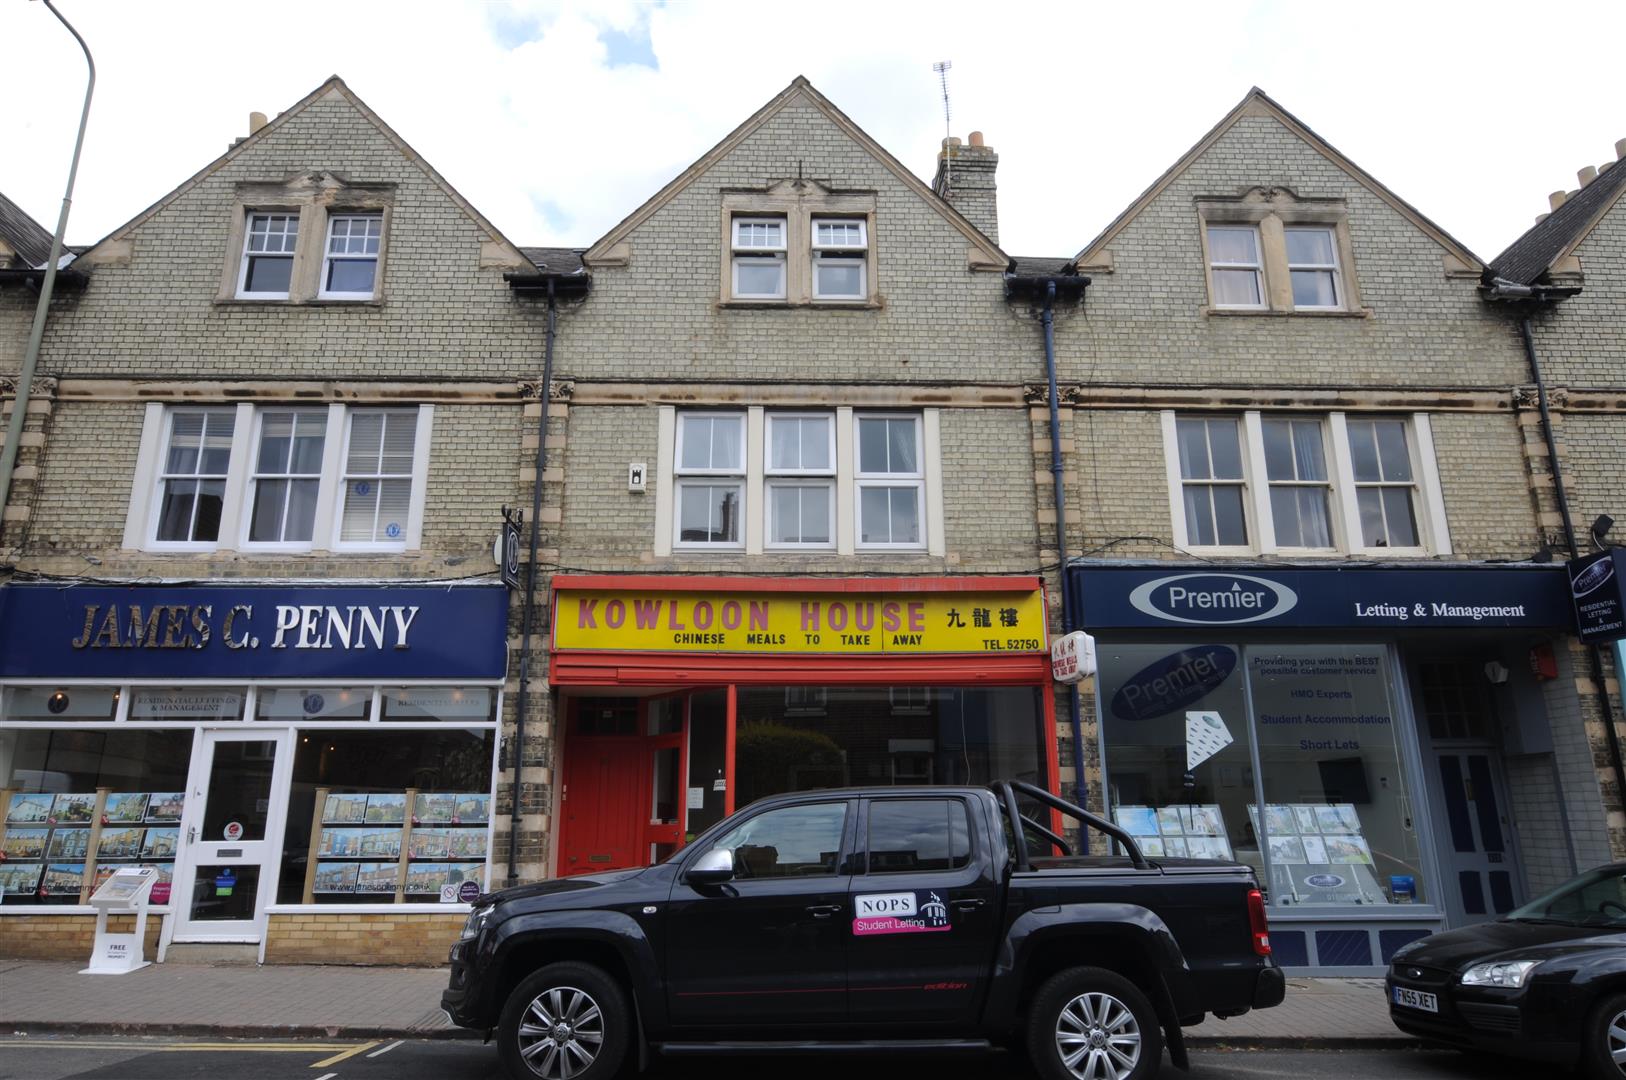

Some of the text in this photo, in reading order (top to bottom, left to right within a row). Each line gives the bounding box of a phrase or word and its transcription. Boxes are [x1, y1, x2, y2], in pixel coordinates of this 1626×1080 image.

[1169, 583, 1265, 608] Premier
[1355, 603, 1526, 620] Letting & Management
[1580, 600, 1616, 611] RESIDENTIAL
[578, 599, 925, 632] KOWLOON HOUSE
[1588, 609, 1612, 618] LETTING
[72, 604, 420, 650] JAMES C. PENNY
[1582, 621, 1622, 633] MANAGEMENT
[674, 633, 922, 646] CHINESE MEALS TO TAKE AWAY
[1254, 657, 1380, 667] Providing you with the BEST
[1260, 667, 1298, 676] possible
[1344, 667, 1377, 675] service
[1122, 652, 1217, 710] Premier
[1290, 689, 1353, 700] HMO Experts
[159, 703, 220, 711] MANAGEMENT
[1260, 714, 1391, 725] Student Accommodation
[1299, 739, 1360, 750] Short Lets
[863, 898, 910, 913] NOPS
[857, 918, 925, 931] Student Letting
[1418, 992, 1435, 1009] XET
